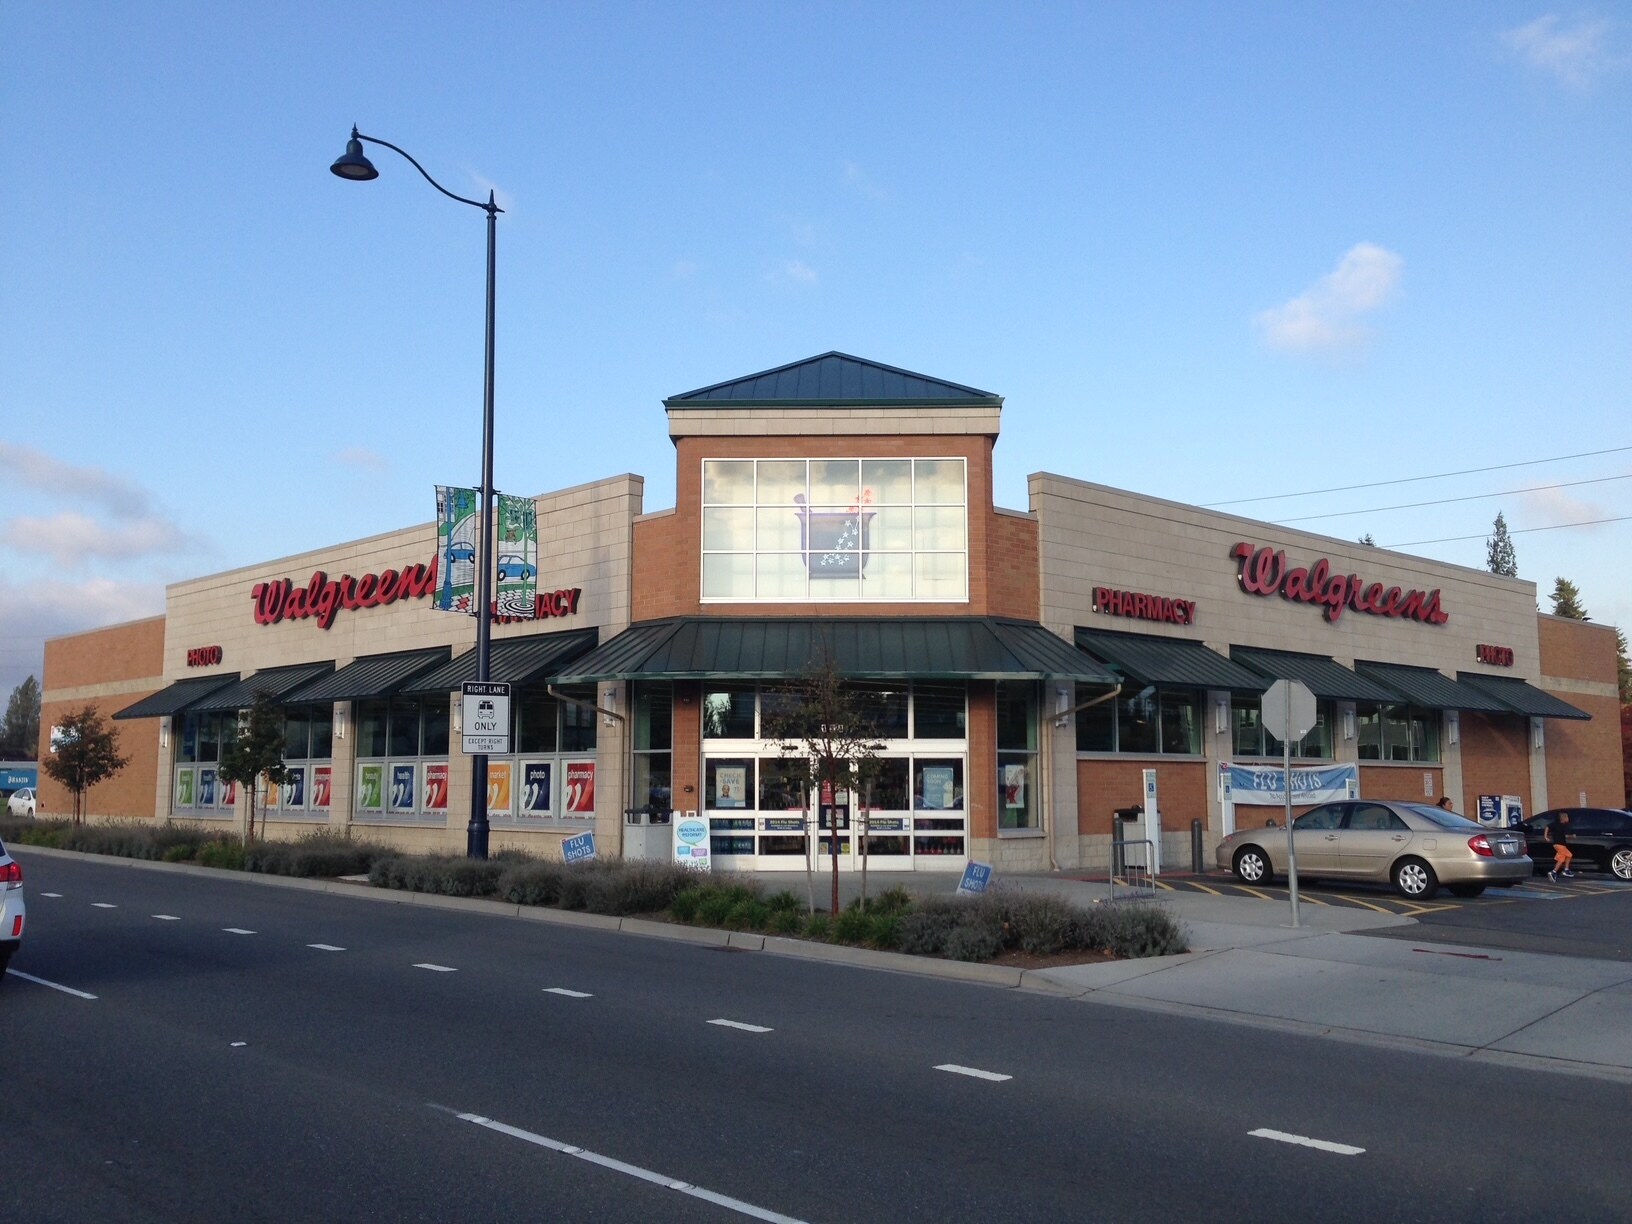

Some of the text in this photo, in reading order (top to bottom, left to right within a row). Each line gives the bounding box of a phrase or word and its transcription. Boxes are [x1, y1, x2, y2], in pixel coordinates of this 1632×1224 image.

[1230, 541, 1449, 623] Walgreens
[1093, 586, 1196, 625] PHARMACY
[187, 645, 222, 666] PHOTO
[467, 685, 505, 694] RIGHT LANE
[474, 721, 497, 731] ONLY
[427, 770, 448, 781] pharmacy
[489, 769, 507, 778] market
[529, 769, 546, 780] photo
[567, 769, 594, 781] pharmacy
[1253, 772, 1277, 790] FLU
[569, 837, 584, 848] FLU
[567, 845, 591, 860] SHOTS
[972, 866, 986, 878] FLU
